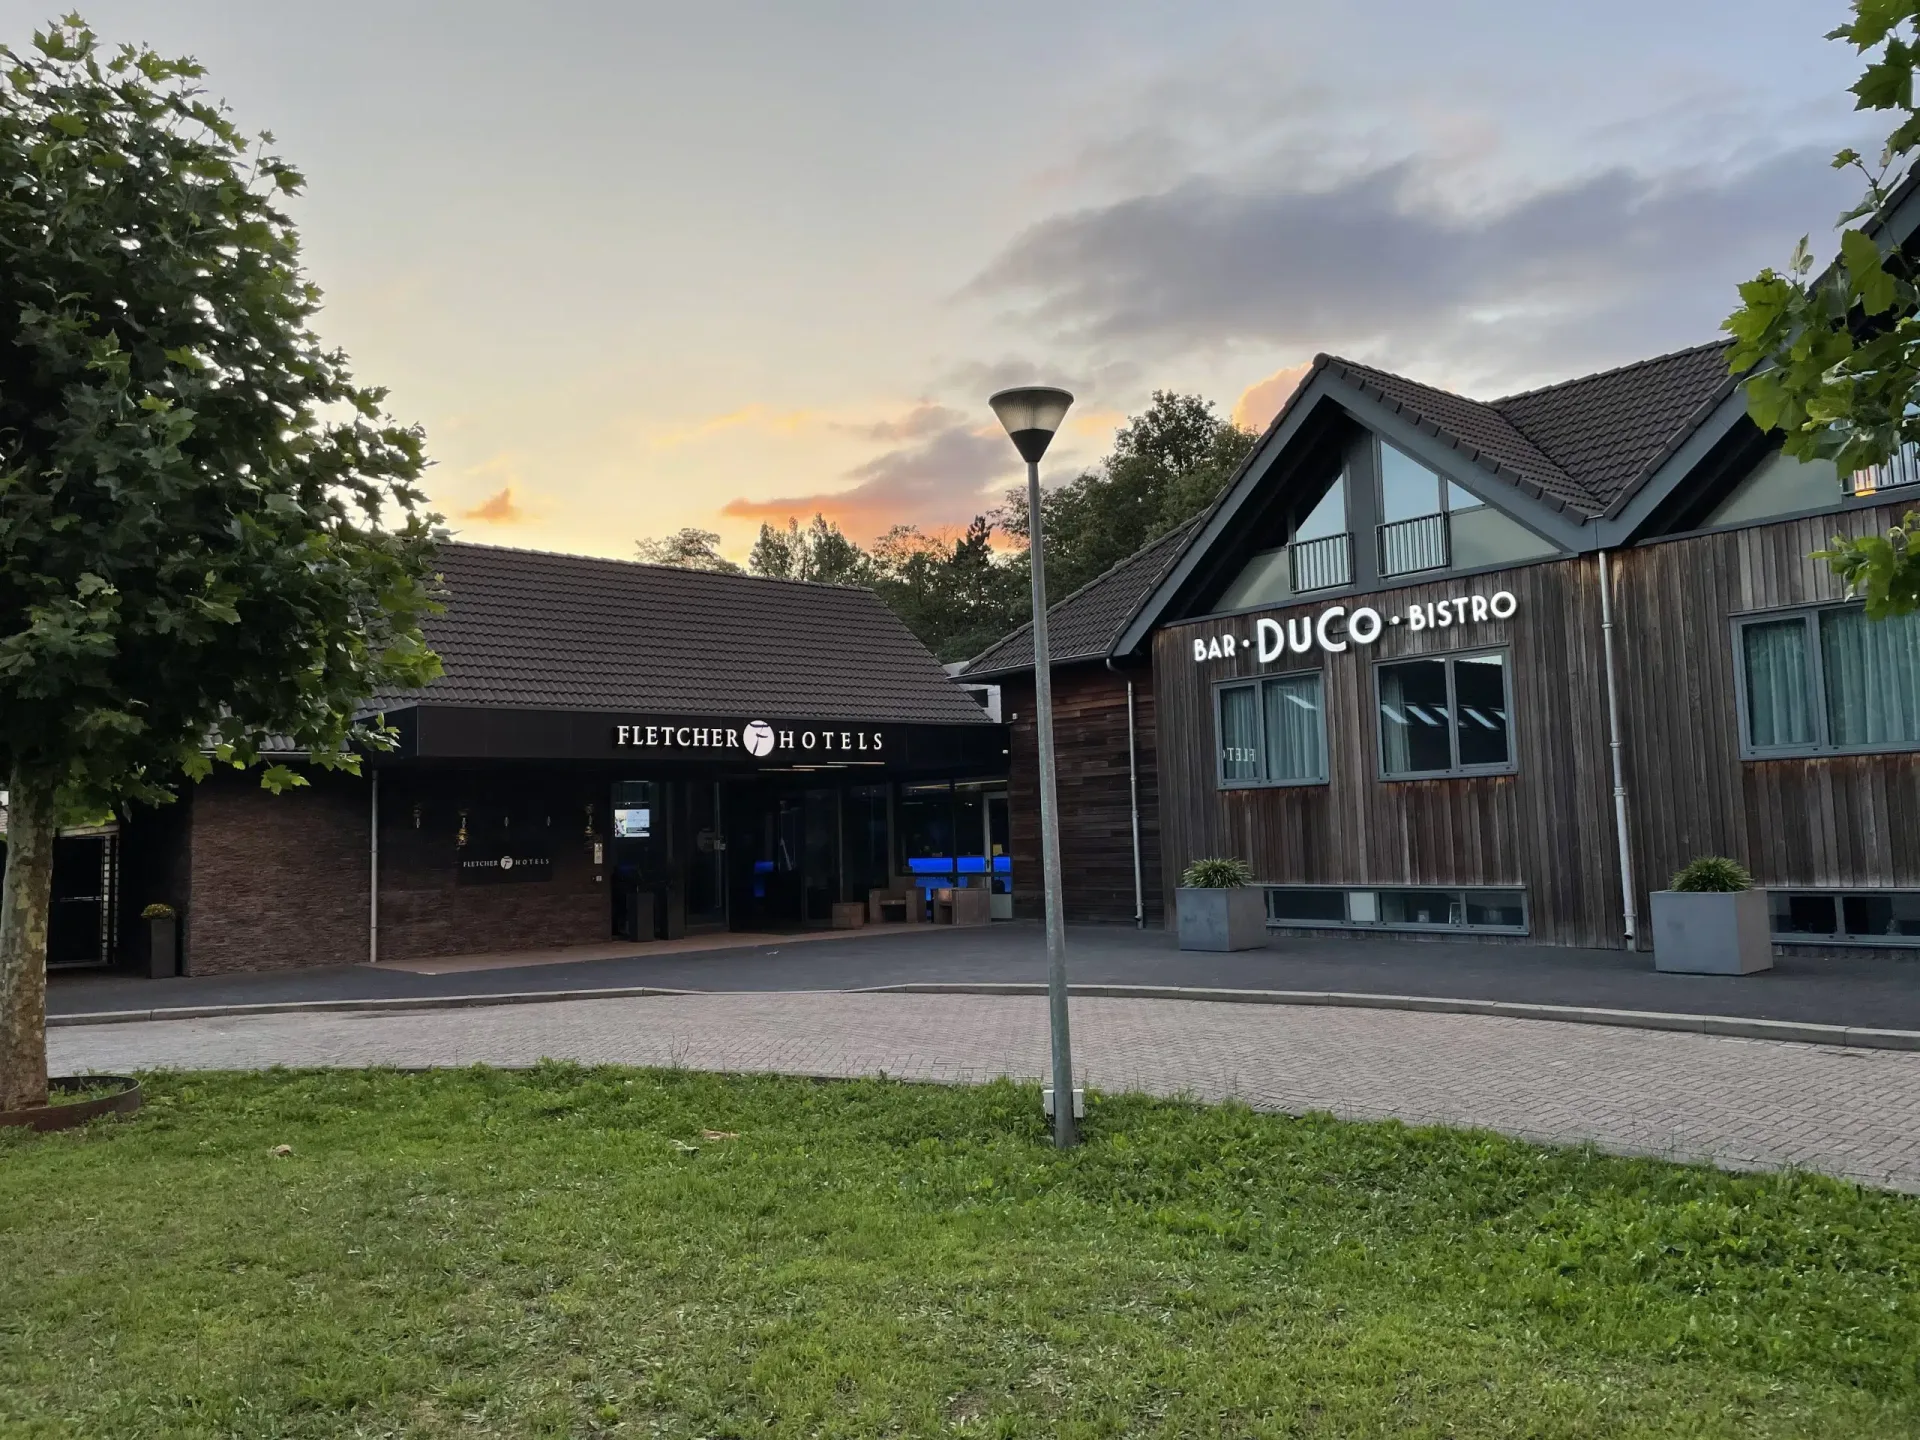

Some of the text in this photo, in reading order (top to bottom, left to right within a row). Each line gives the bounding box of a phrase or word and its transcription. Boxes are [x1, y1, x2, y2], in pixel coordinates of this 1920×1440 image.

[1194, 634, 1236, 662] BAR
[1409, 591, 1517, 631] BISTRO
[616, 725, 740, 748] FLETCHER
[778, 730, 883, 750] HOTELS
